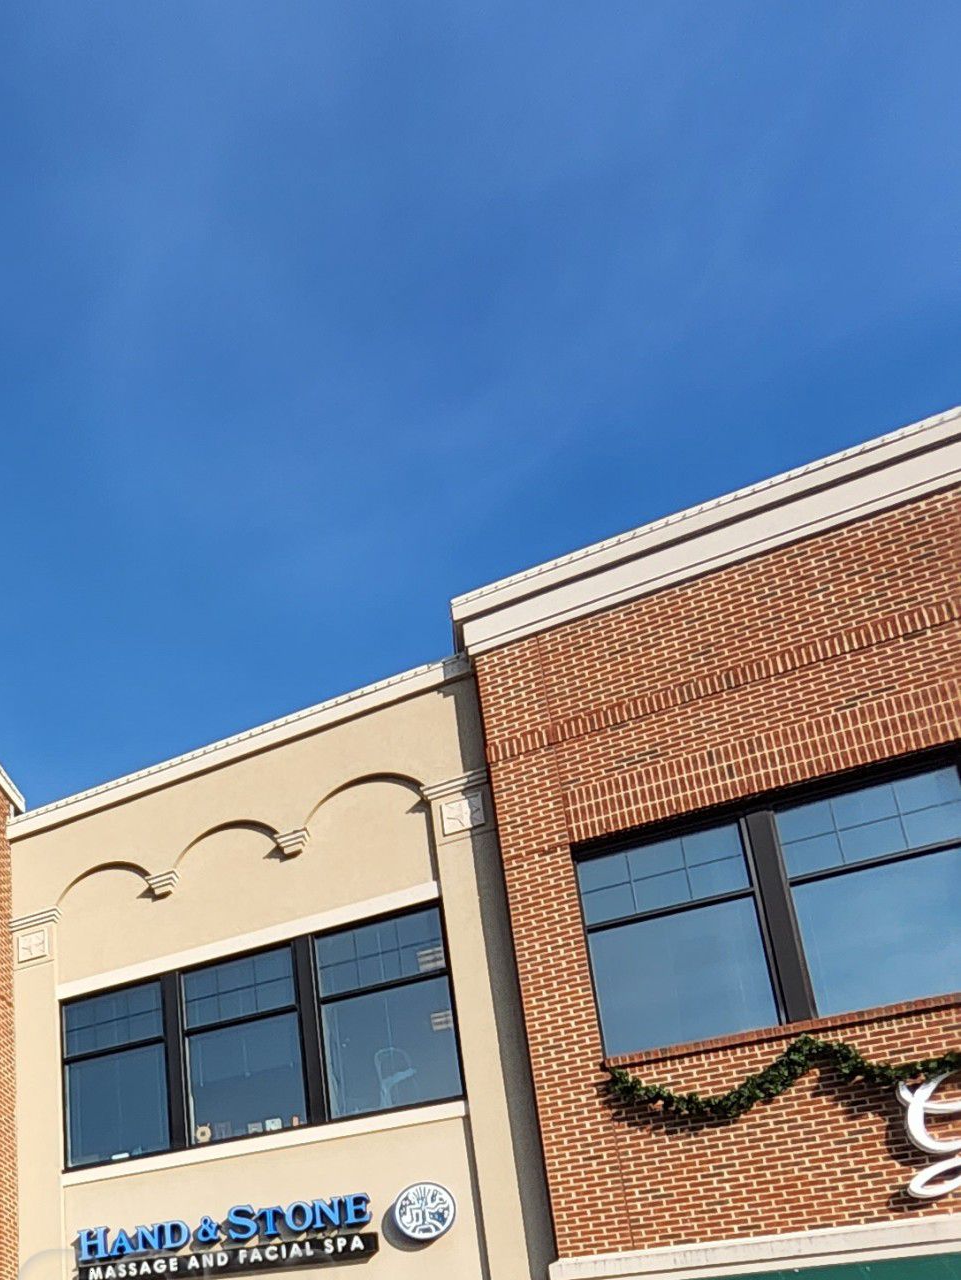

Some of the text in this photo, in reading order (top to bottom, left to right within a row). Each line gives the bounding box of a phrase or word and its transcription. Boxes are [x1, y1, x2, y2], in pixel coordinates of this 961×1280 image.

[77, 1192, 372, 1262] HAND & STONE
[188, 1251, 229, 1271] AND
[238, 1243, 314, 1265] FACIAL
[324, 1236, 365, 1255] SPA
